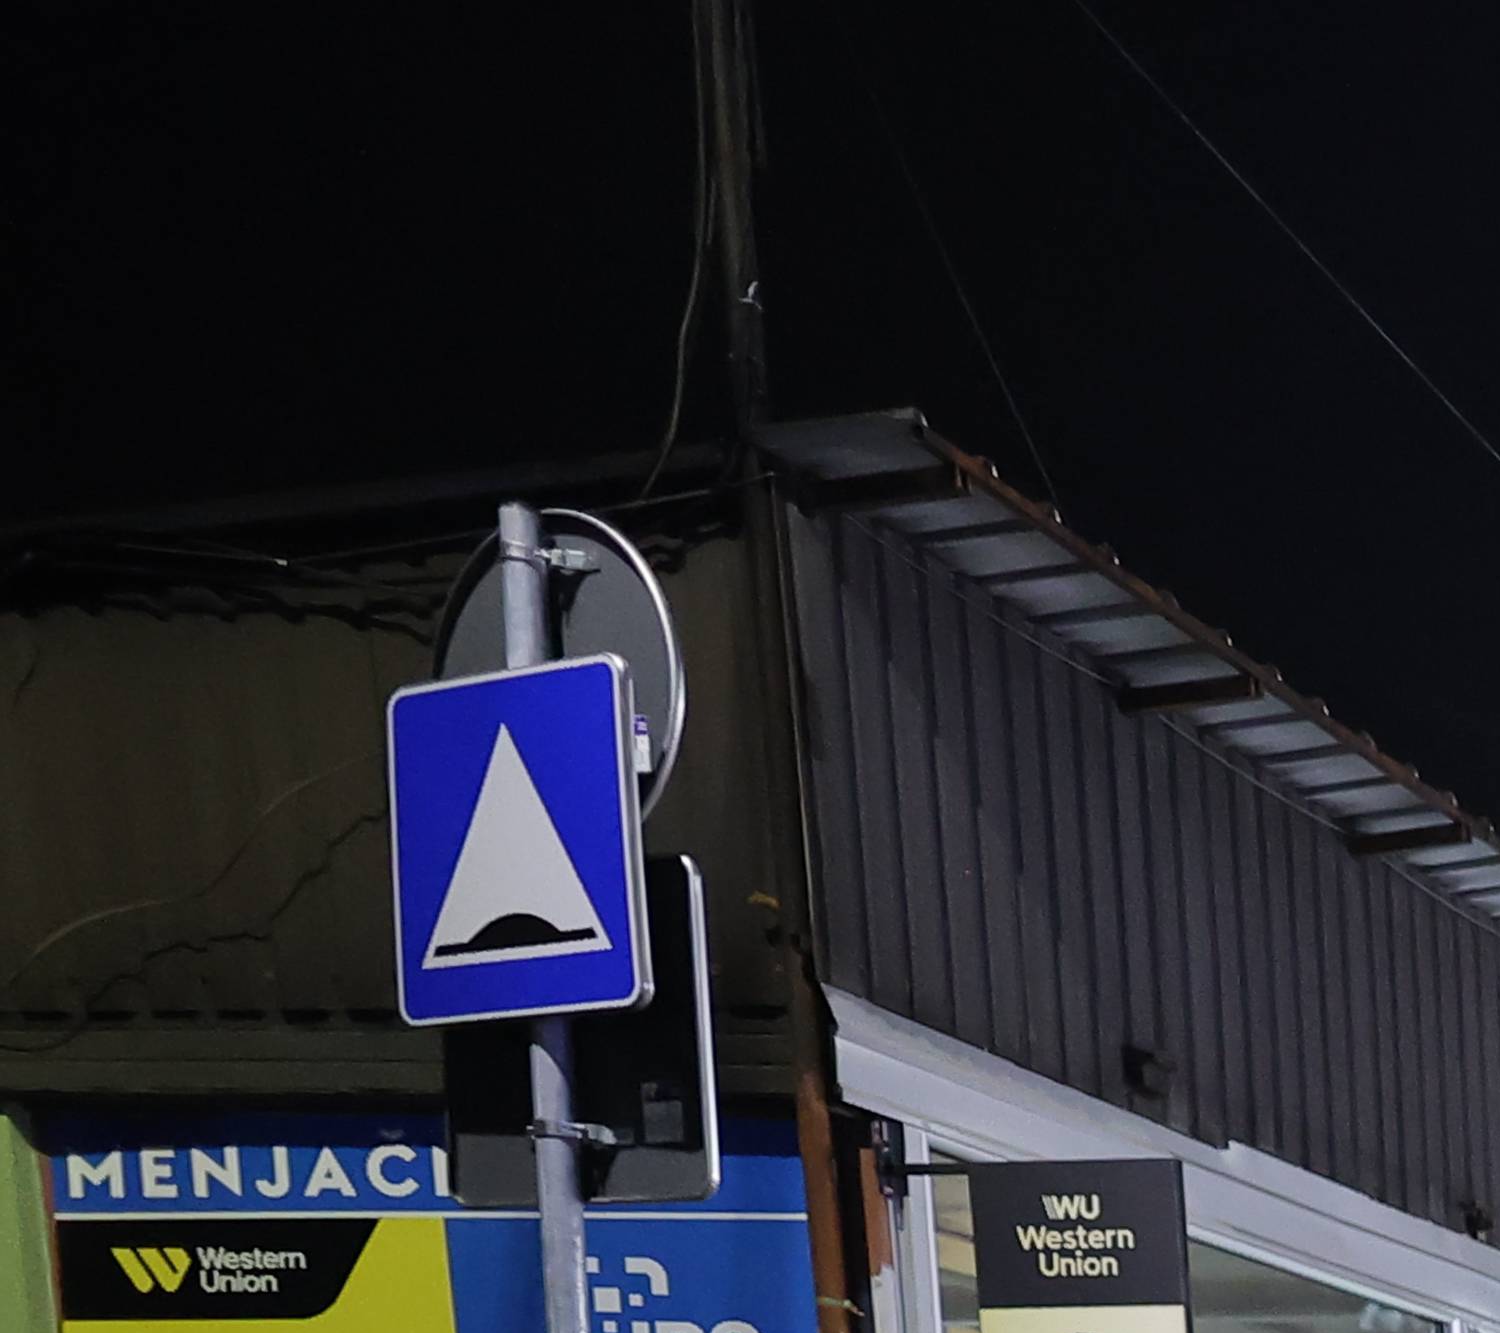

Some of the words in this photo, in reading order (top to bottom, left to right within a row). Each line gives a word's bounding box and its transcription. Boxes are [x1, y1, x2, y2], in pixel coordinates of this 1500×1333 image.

[1016, 1225, 1136, 1250] Western
[196, 1247, 307, 1270] Western
[1038, 1250, 1119, 1277] Union
[200, 1271, 279, 1293] Union
